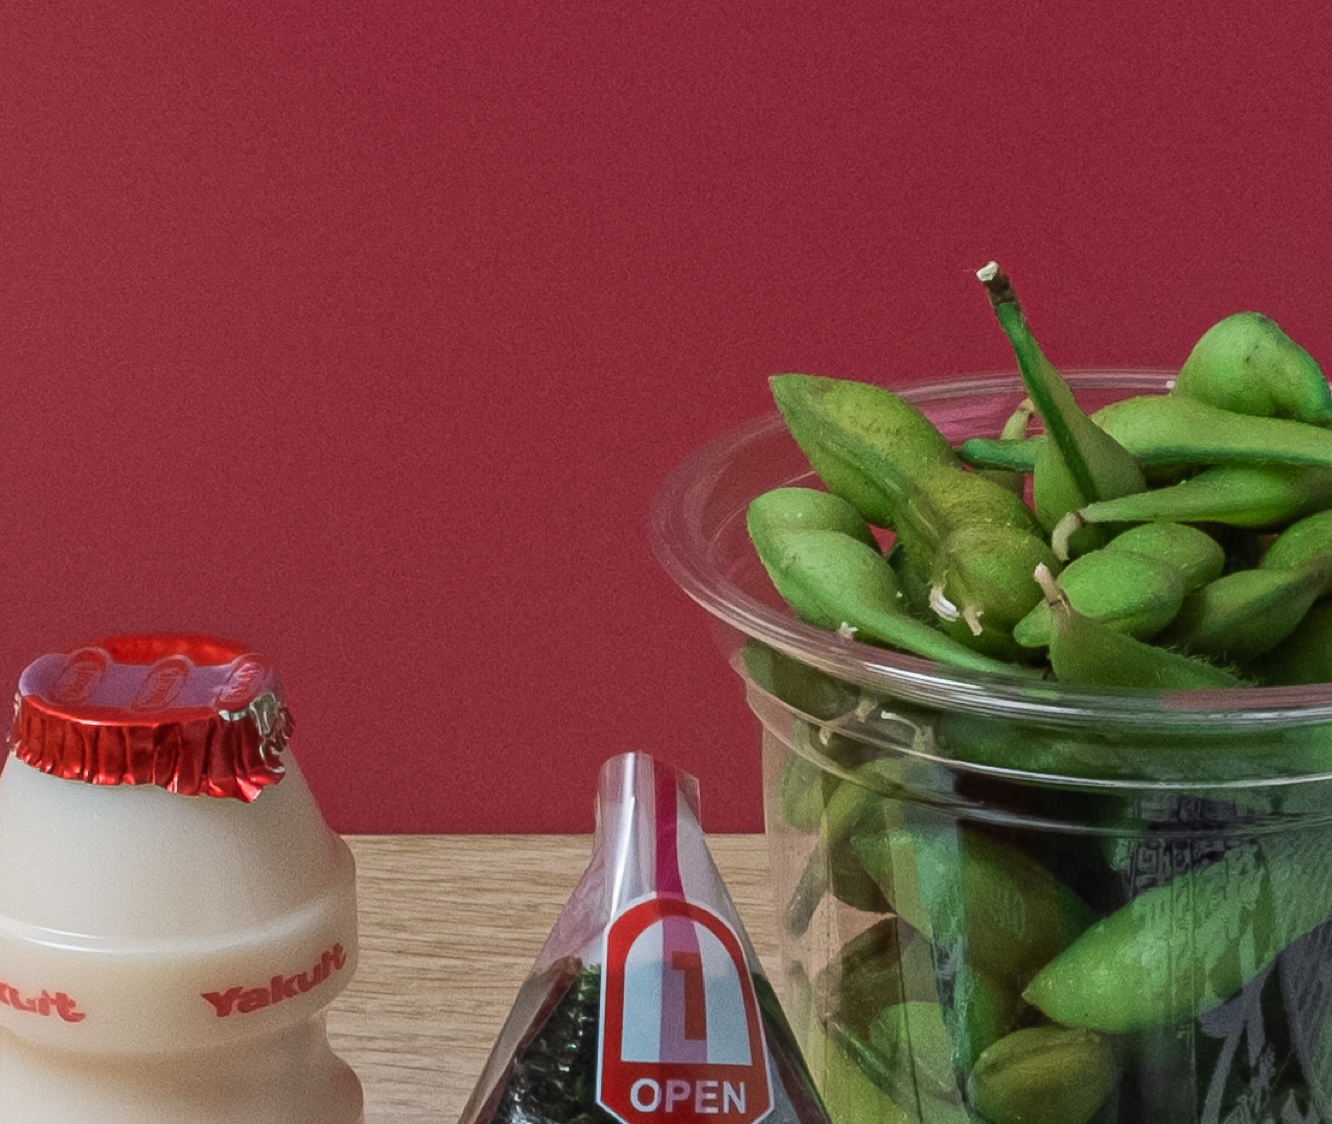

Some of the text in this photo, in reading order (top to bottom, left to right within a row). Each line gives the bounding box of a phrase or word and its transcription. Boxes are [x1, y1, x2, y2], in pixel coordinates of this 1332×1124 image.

[201, 942, 347, 1019] Yakult
[671, 951, 706, 1040] 1
[630, 1078, 746, 1114] OPEN
